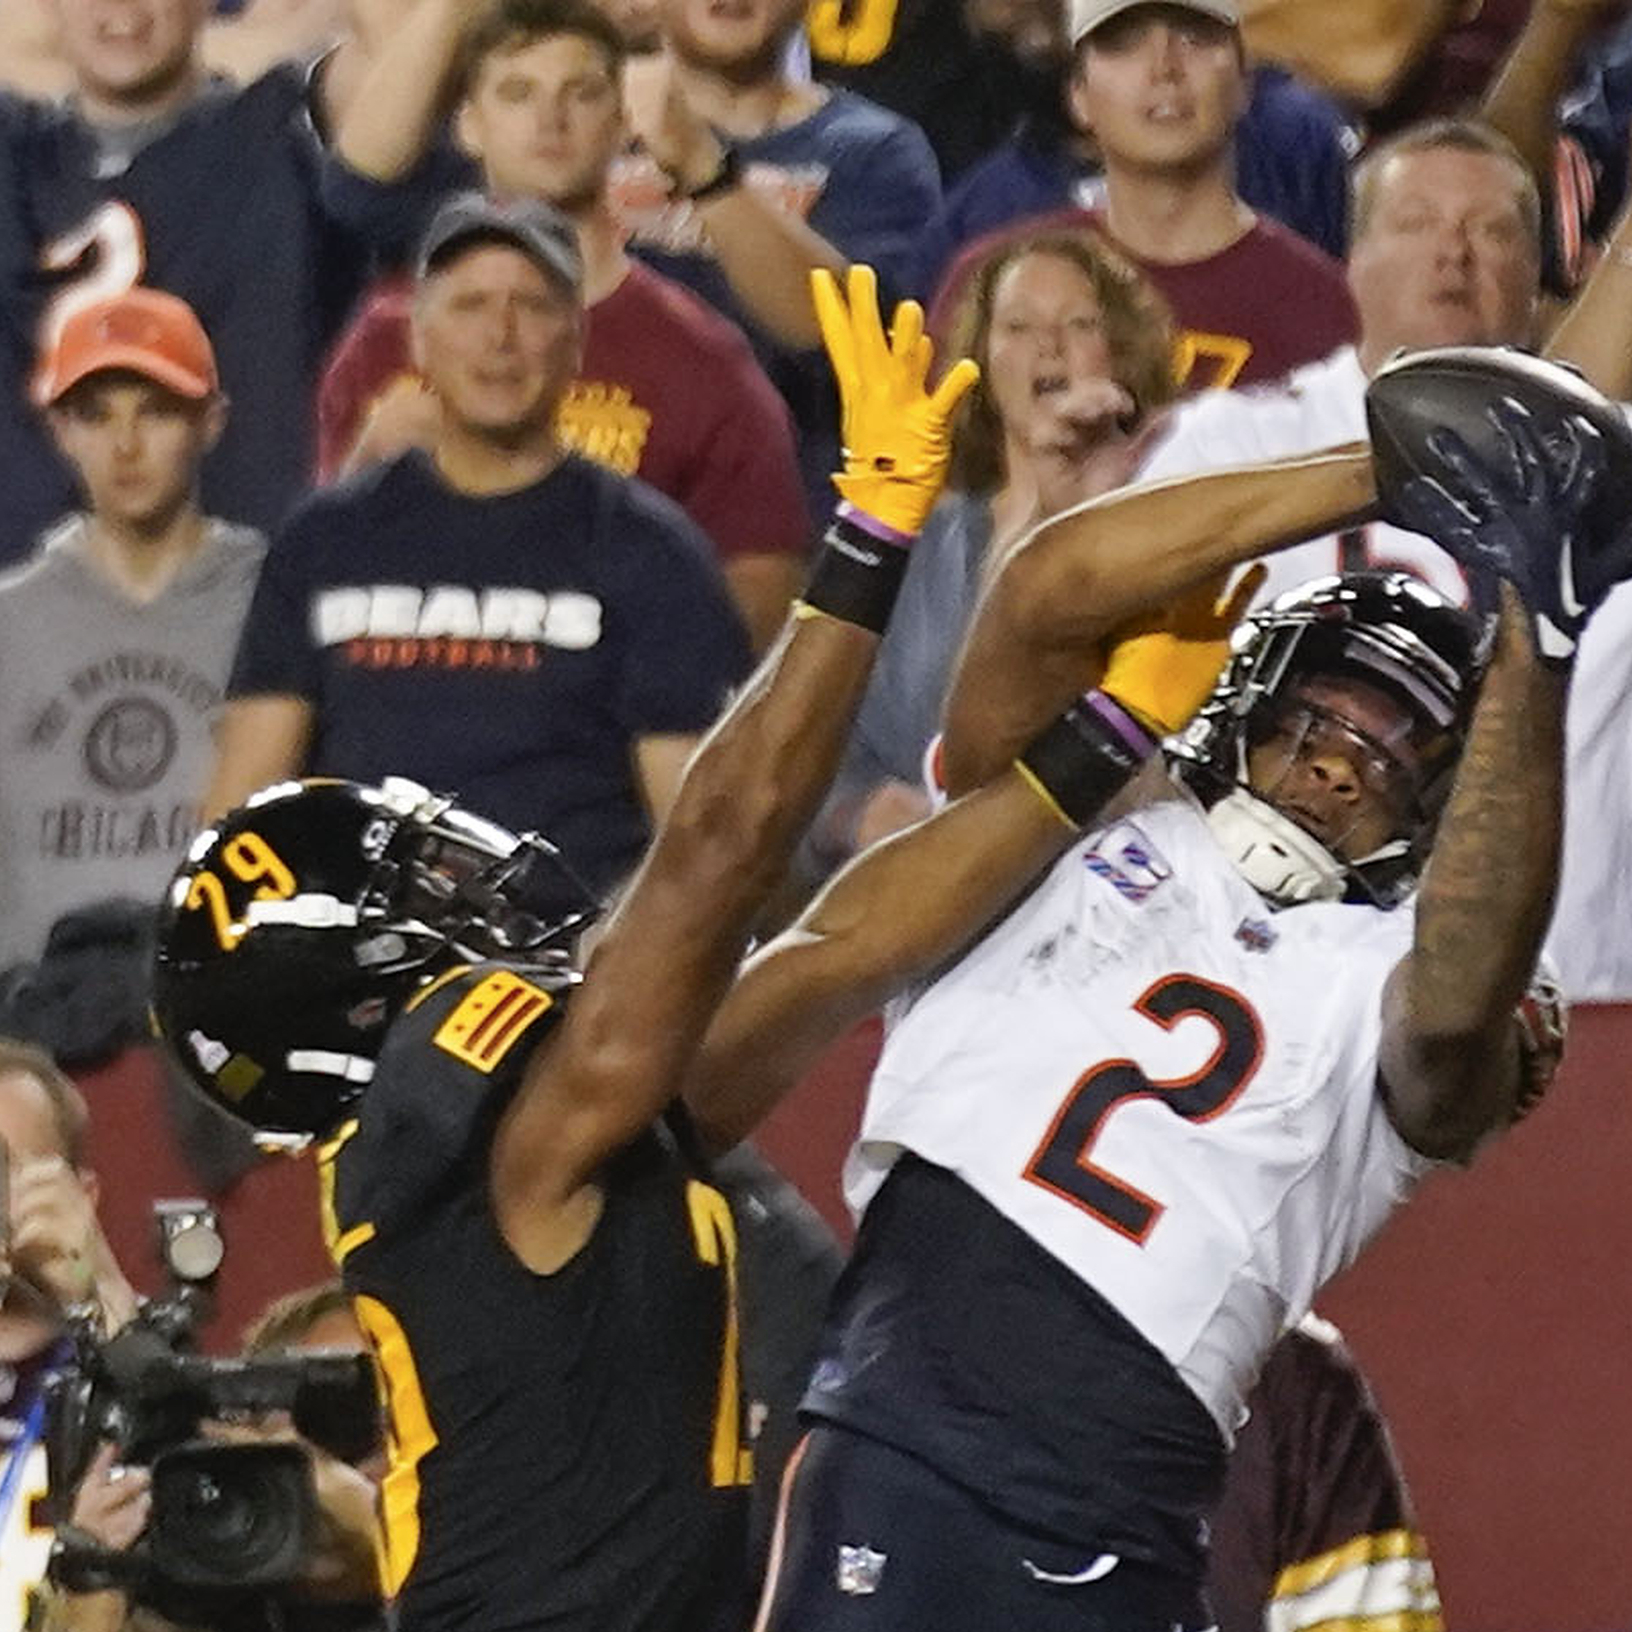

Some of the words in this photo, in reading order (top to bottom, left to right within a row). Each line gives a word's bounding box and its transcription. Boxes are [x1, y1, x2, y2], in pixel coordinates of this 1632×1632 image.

[311, 584, 604, 651] BEARS
[344, 635, 542, 671] FOOTBALL
[185, 830, 298, 951] 29
[1021, 972, 1267, 1247] 2
